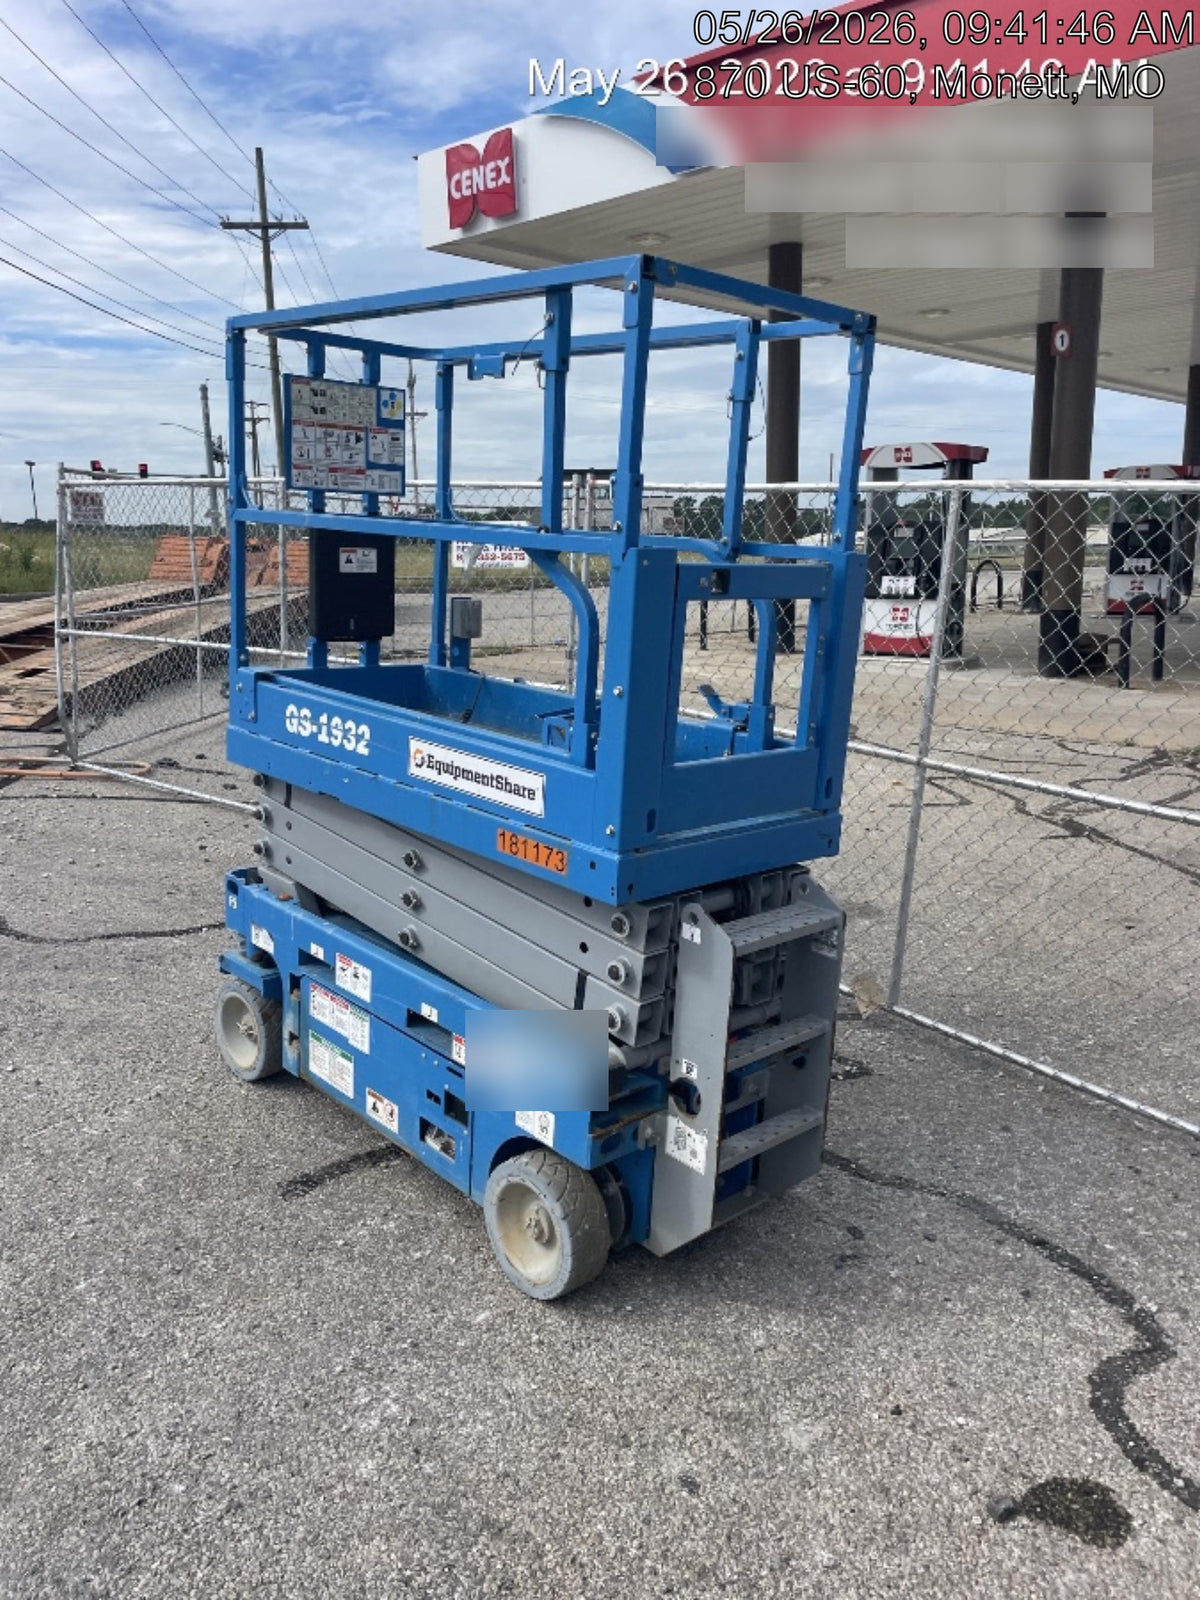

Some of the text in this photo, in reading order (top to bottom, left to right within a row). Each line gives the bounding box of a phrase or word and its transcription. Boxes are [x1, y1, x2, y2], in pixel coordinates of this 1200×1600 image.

[450, 156, 511, 200] CENEX
[285, 703, 371, 757] GS-1932
[426, 753, 536, 801] EquipmentShare
[499, 831, 566, 872] 181173
